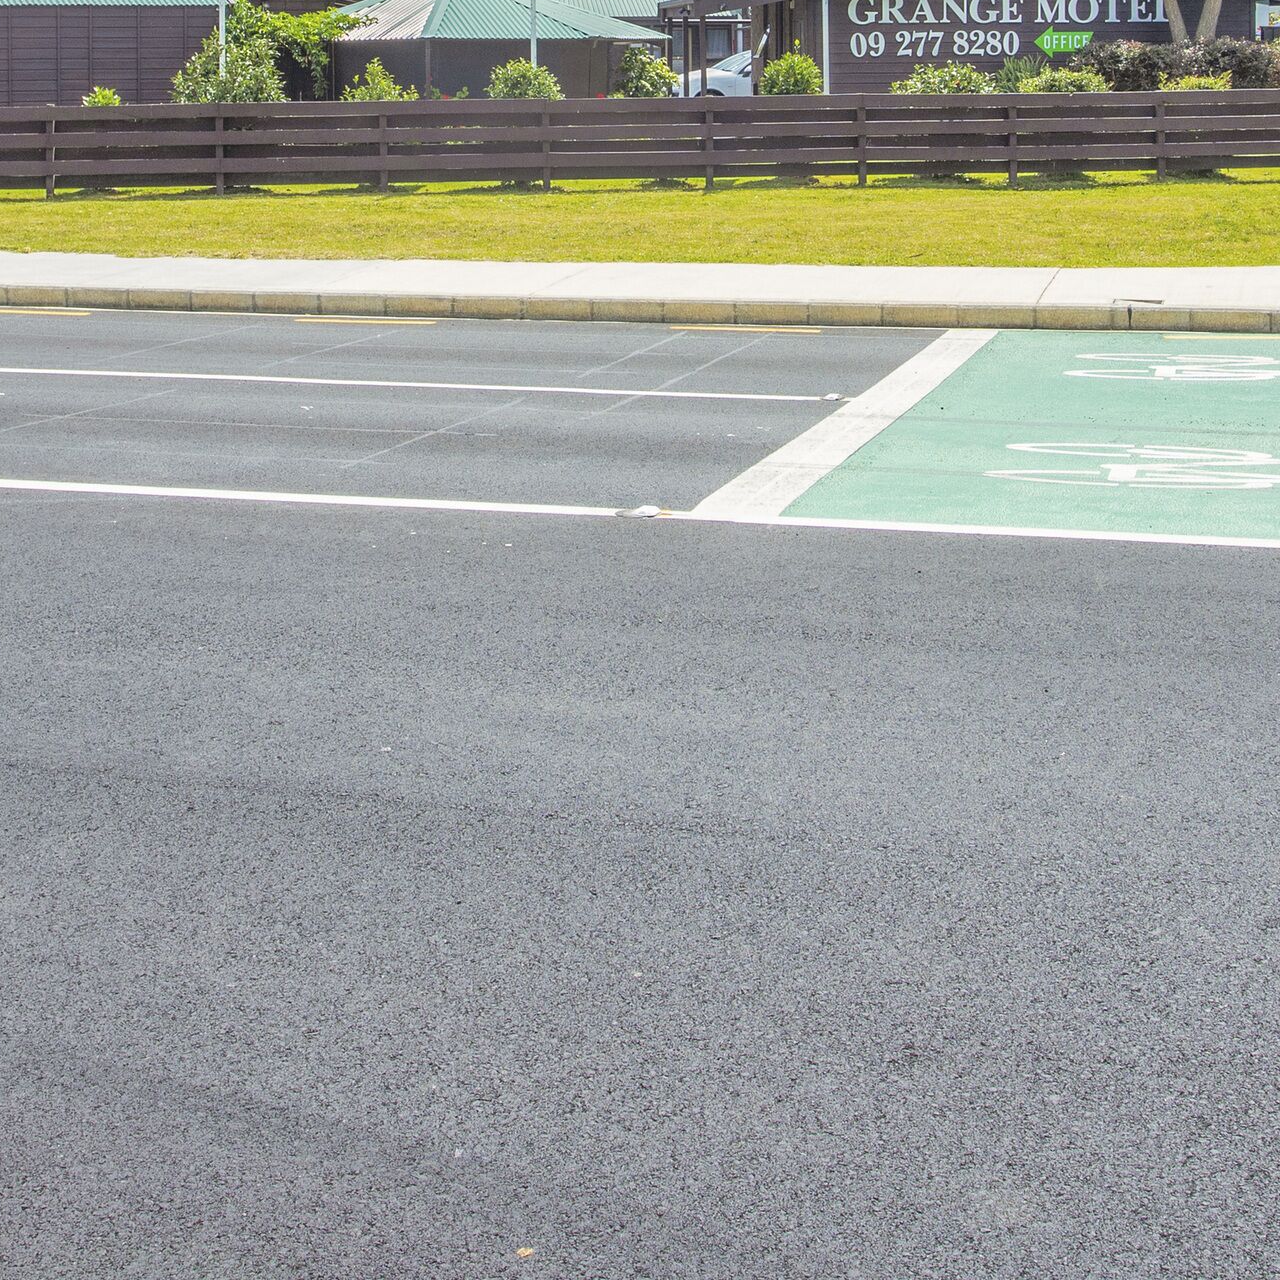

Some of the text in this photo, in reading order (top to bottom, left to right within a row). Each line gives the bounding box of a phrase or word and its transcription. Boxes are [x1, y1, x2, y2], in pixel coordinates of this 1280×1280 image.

[850, 29, 1020, 58] 09 277 8280
